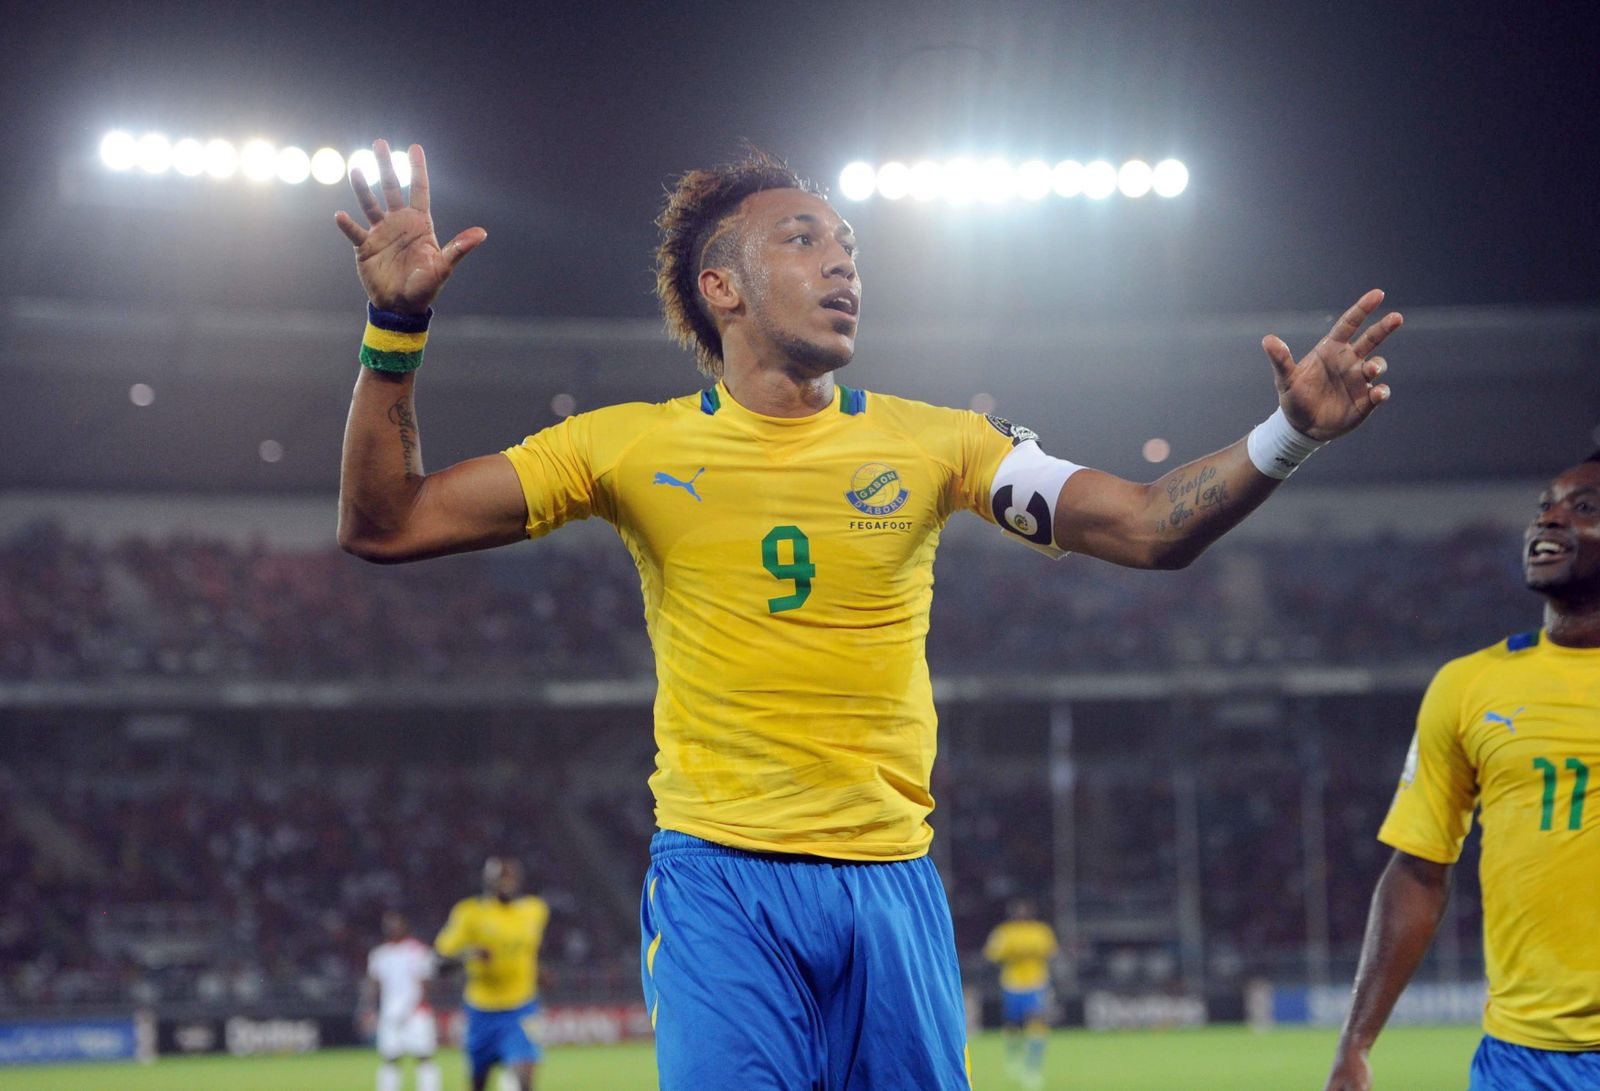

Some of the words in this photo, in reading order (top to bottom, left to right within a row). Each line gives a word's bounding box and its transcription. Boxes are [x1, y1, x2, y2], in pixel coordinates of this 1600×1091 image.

[859, 472, 896, 498] GABON
[850, 521, 913, 530] FEGAFOOT
[761, 525, 816, 614] 9
[1532, 757, 1589, 831] 11
